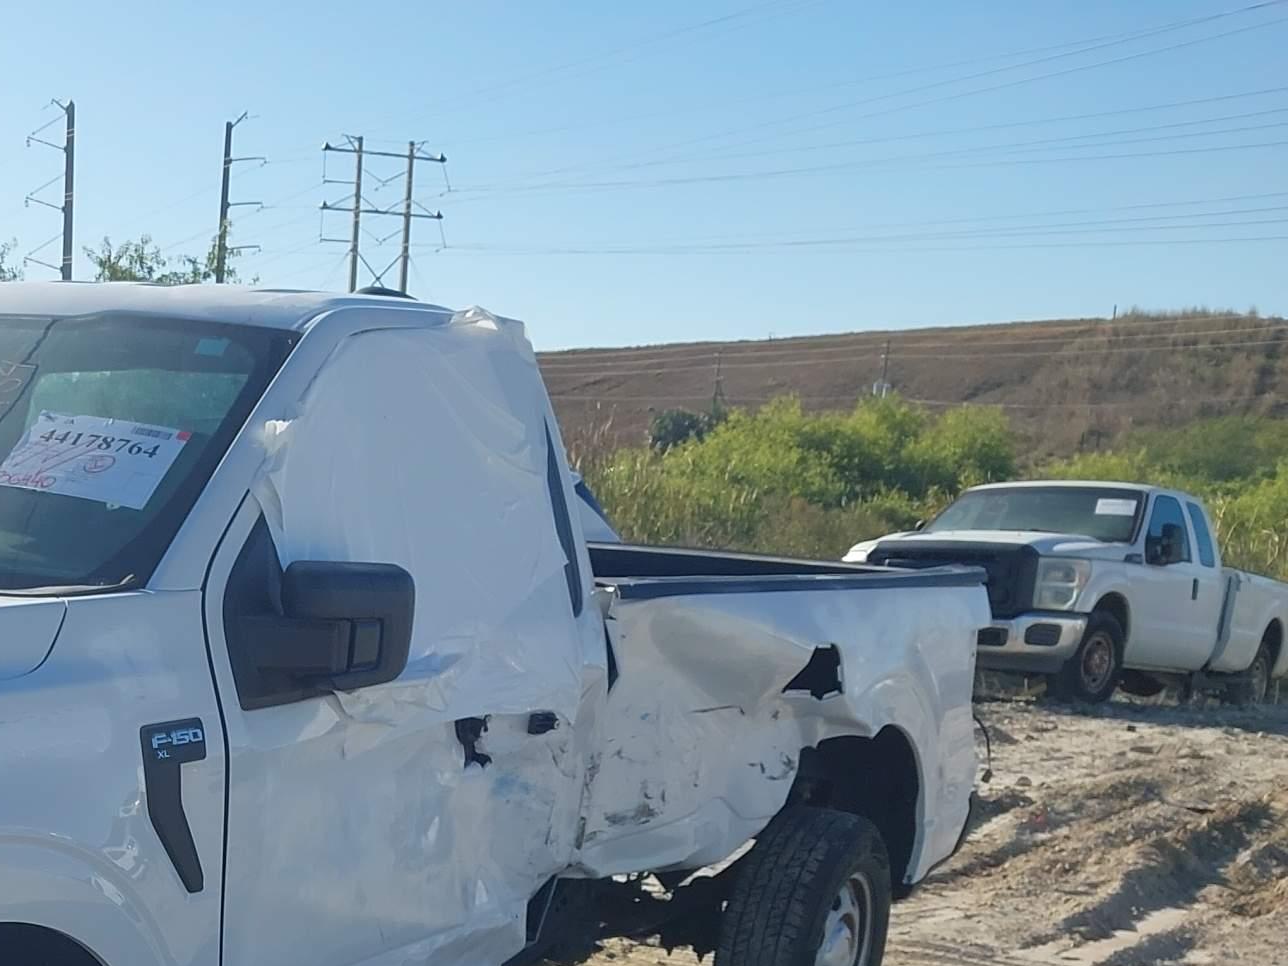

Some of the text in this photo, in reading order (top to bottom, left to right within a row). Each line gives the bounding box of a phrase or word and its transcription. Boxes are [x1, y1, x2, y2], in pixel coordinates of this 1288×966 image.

[39, 428, 161, 458] 44178764
[152, 728, 203, 749] F-150
[157, 750, 170, 759] XL
